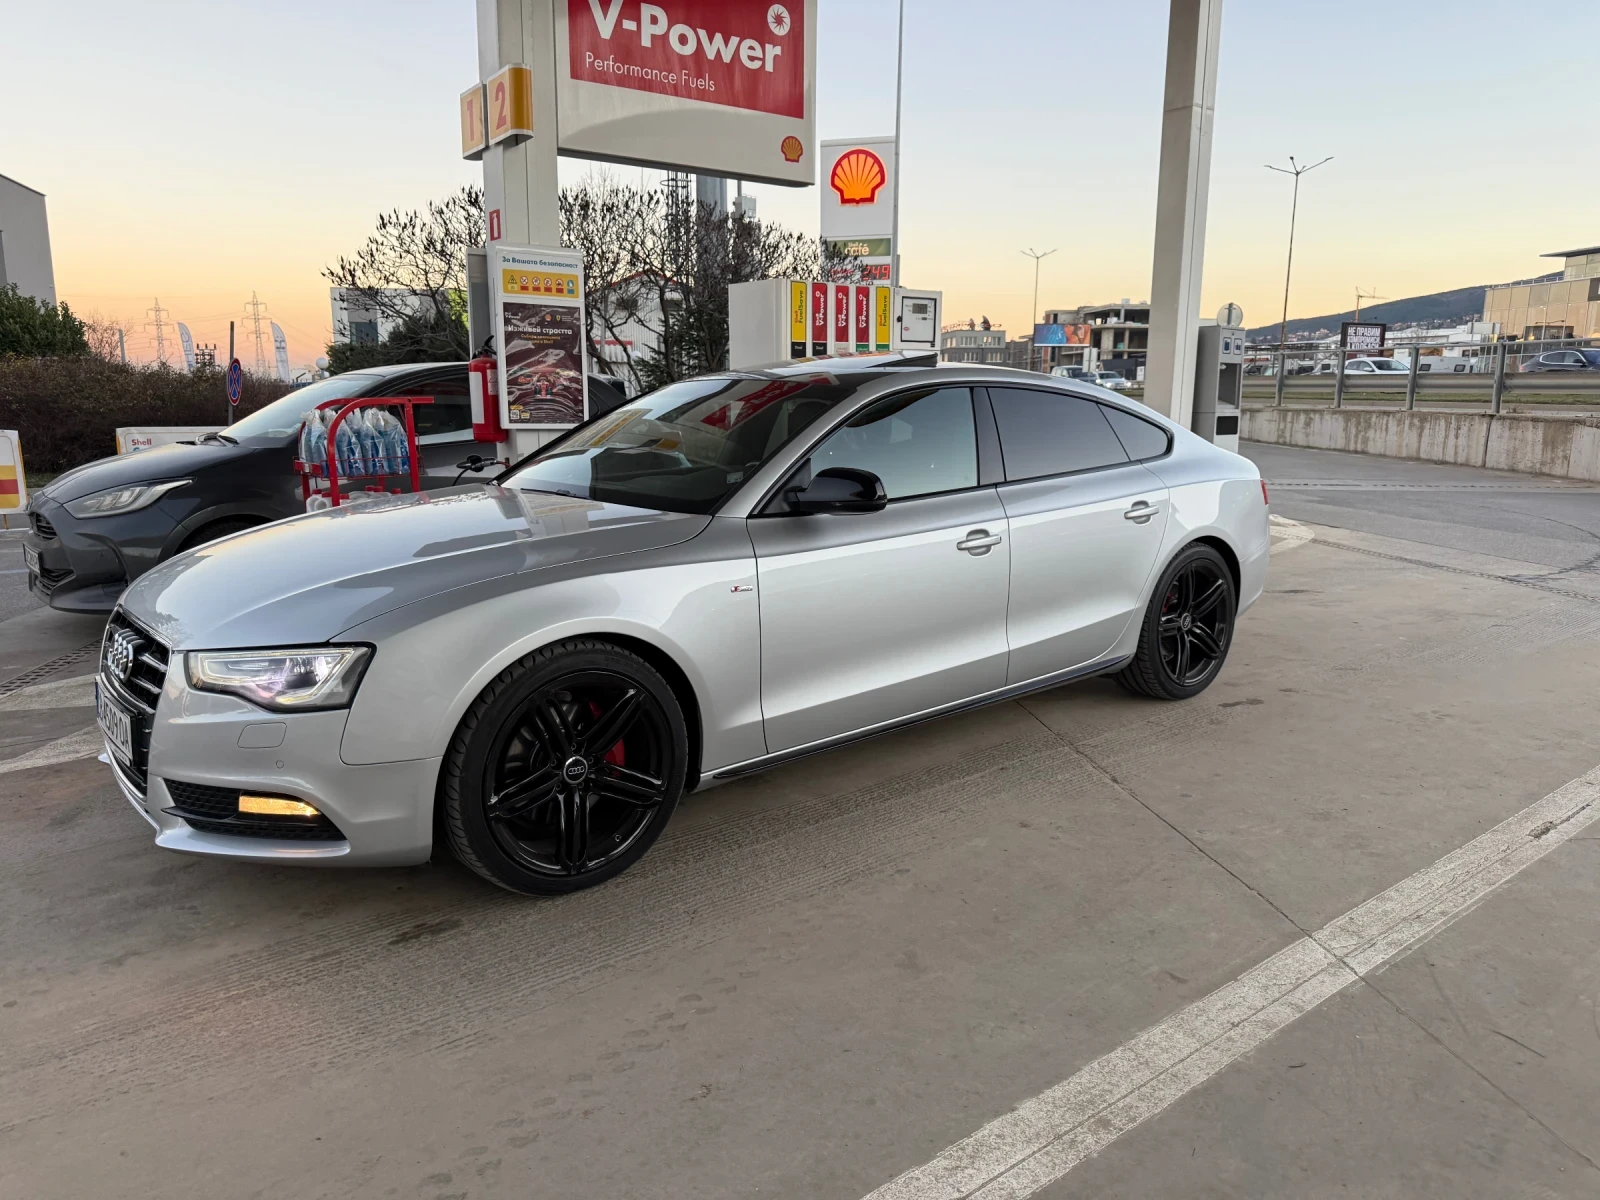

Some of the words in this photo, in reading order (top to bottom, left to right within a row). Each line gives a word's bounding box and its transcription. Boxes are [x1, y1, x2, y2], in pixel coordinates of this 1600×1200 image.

[588, 0, 782, 73] V-Power
[585, 51, 677, 84] Performance
[681, 70, 716, 91] Fuels
[494, 81, 507, 130] 2
[466, 98, 475, 142] 1
[845, 243, 869, 256] café
[511, 257, 538, 265] Вашата
[539, 259, 578, 269] безопасност
[508, 324, 541, 333] Изживей
[542, 327, 573, 335] страстта
[1348, 327, 1356, 336] НЕ
[1357, 327, 1380, 337] ПРАВИМ
[131, 438, 152, 446] Shell
